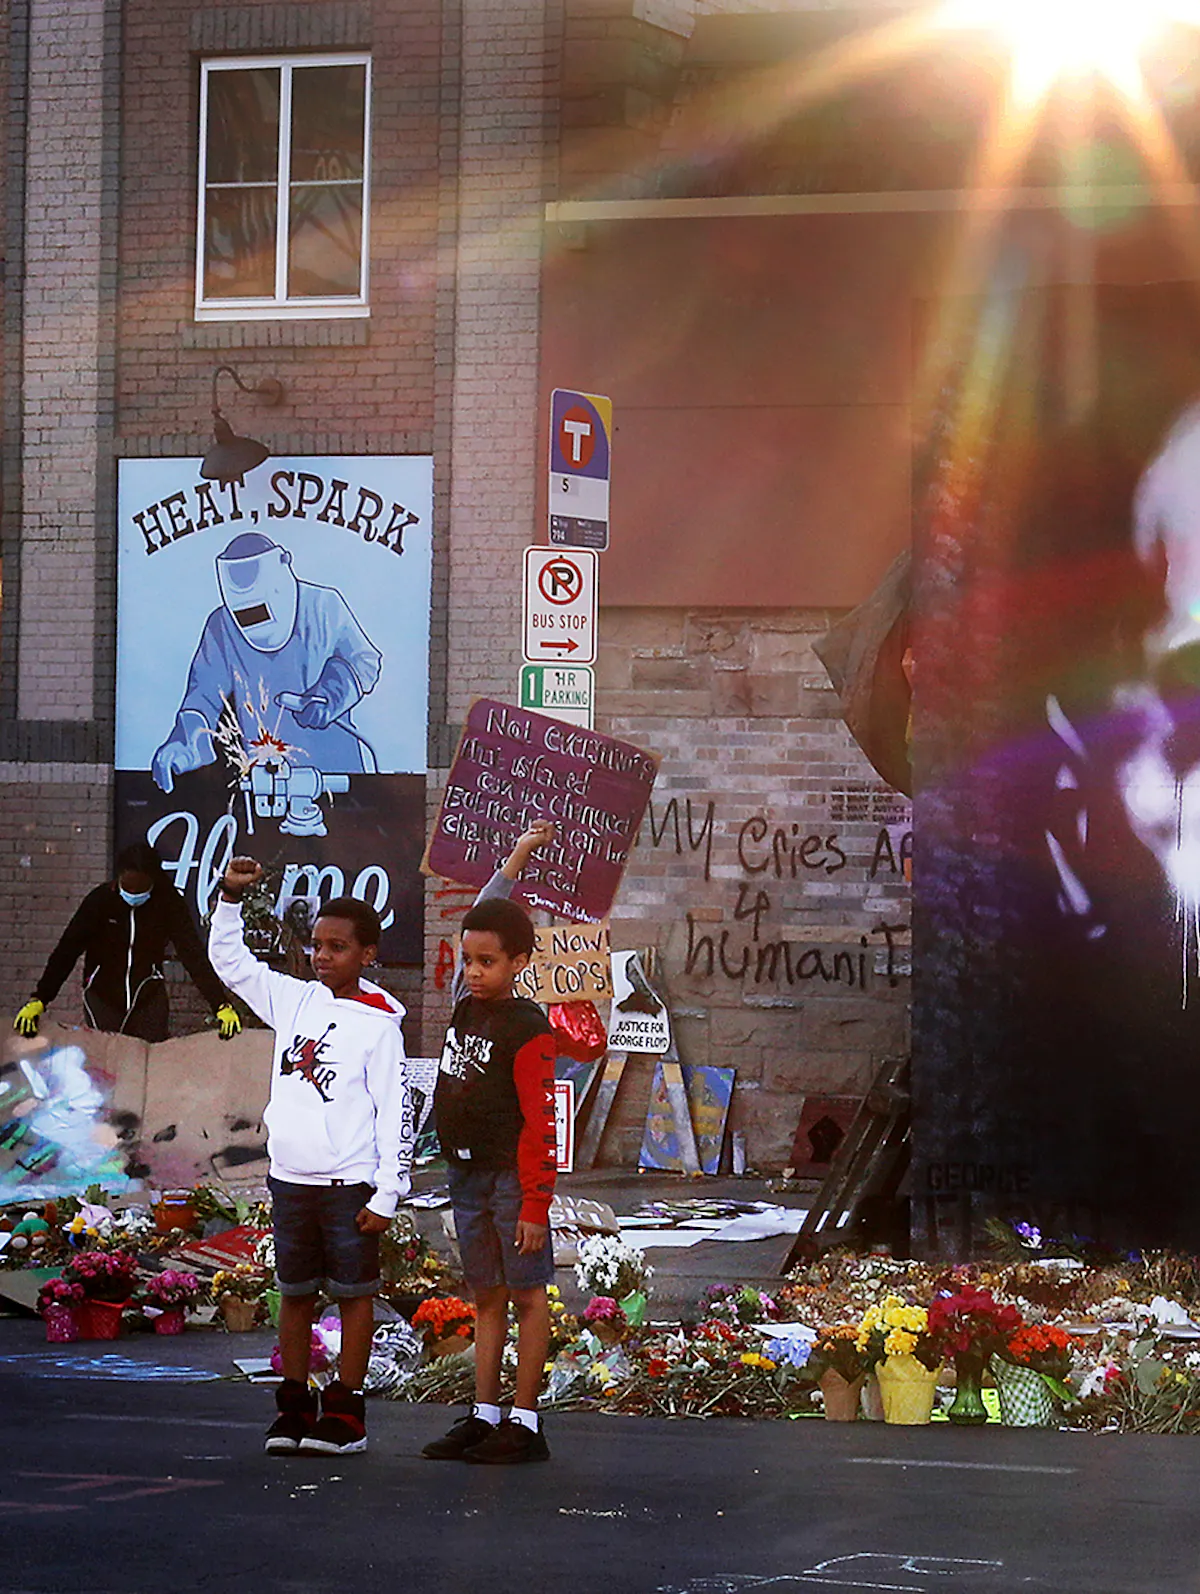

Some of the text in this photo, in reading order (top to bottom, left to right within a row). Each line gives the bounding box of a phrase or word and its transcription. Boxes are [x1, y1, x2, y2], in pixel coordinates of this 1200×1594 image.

[564, 420, 591, 462] T
[561, 478, 570, 493] 5
[132, 470, 420, 556] HEAT, SPARK
[533, 613, 588, 630] BUS STOP
[527, 672, 577, 702] 1 HR
[544, 690, 588, 706] PARKING
[487, 708, 533, 744] Not
[737, 816, 847, 876] Cries
[146, 811, 395, 931] Flme
[609, 1034, 668, 1049] GEORGE FLOYD
[616, 1020, 664, 1034] JUSTICE FOR
[396, 1061, 415, 1182] AIR JORDAN
